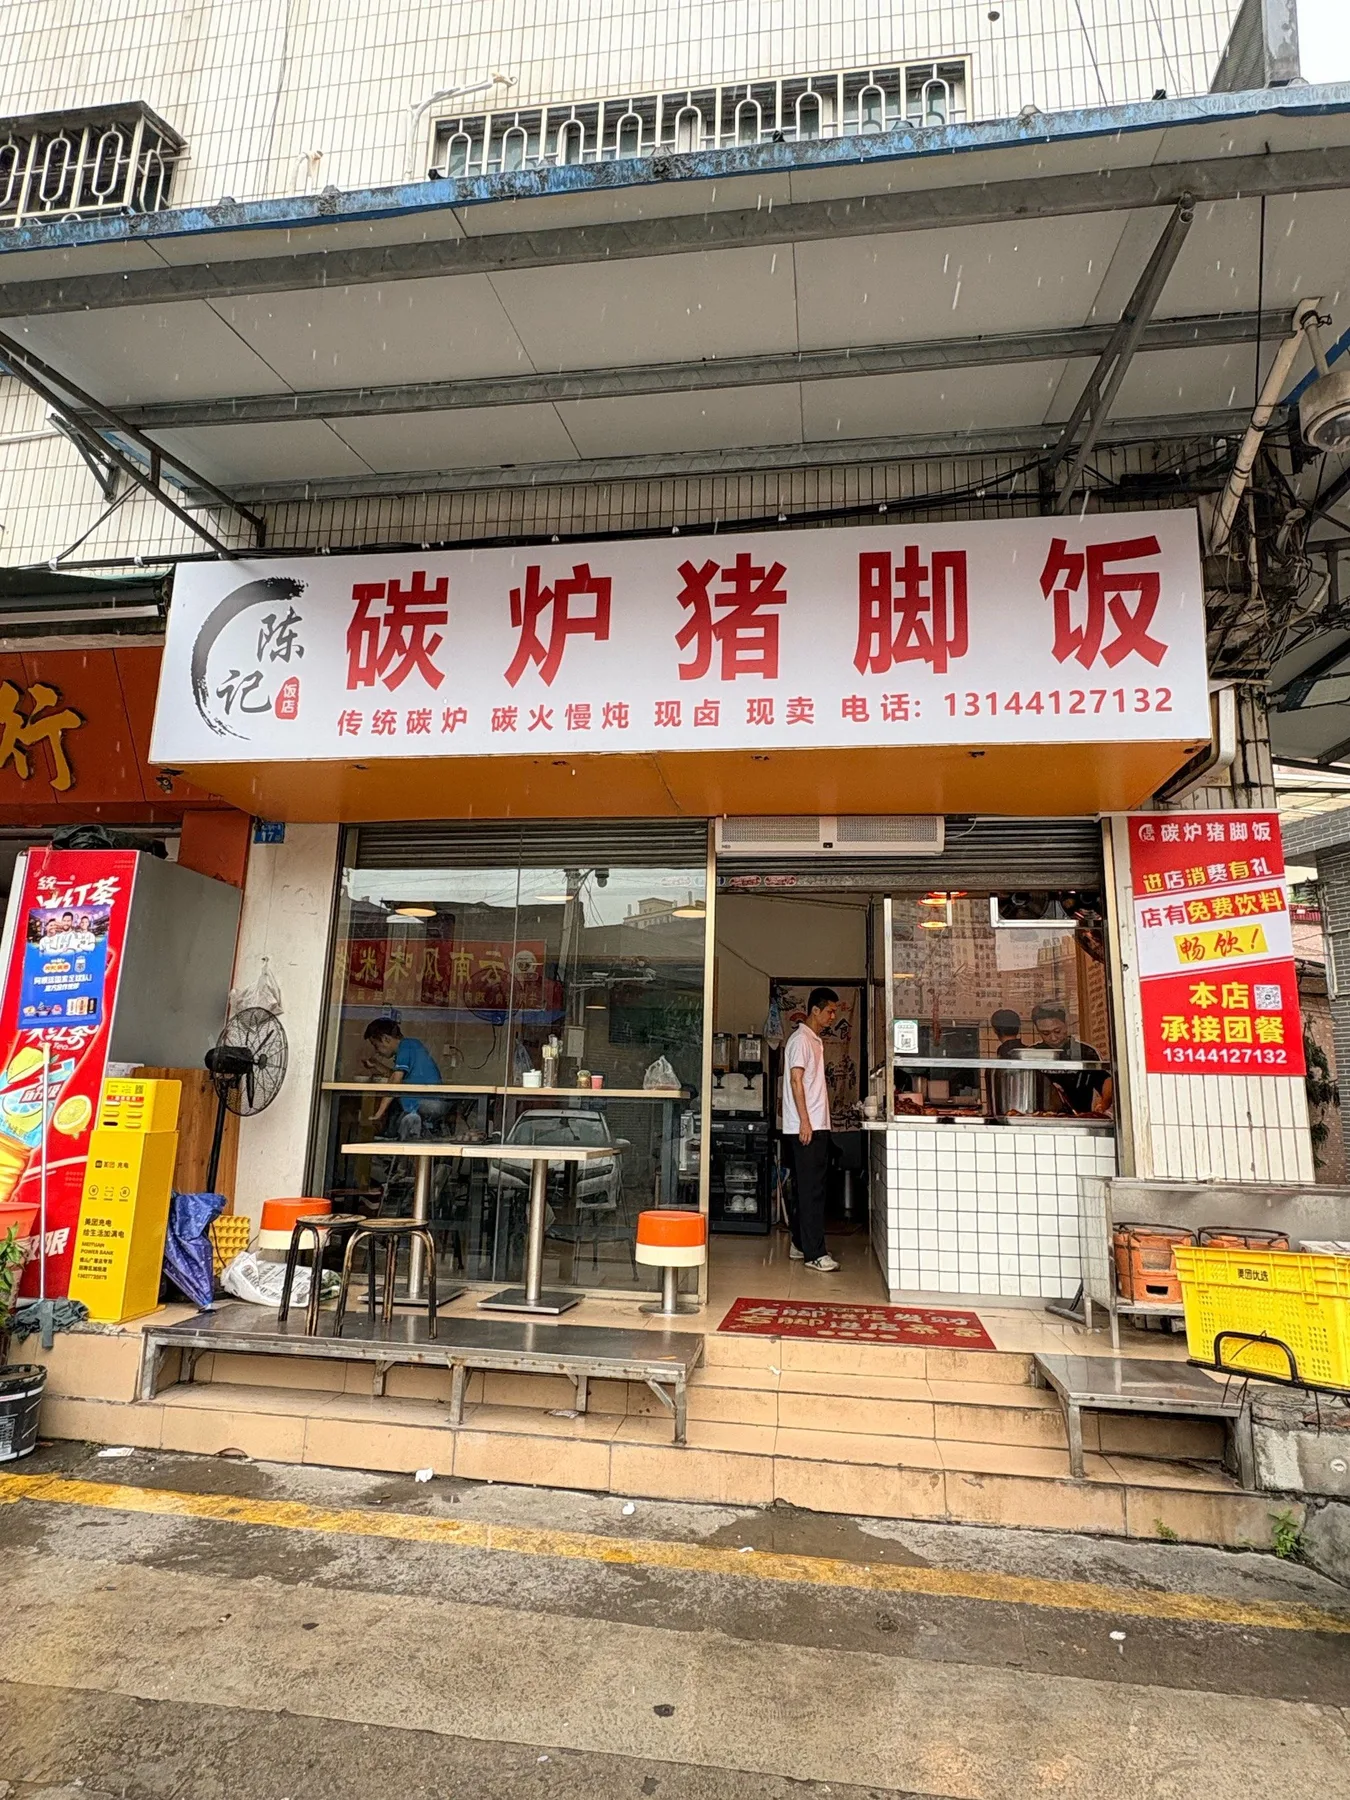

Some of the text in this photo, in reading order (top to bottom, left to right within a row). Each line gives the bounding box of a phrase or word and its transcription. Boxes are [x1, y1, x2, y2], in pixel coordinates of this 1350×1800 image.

[345, 535, 1169, 692] 碳炉猪脚饭
[279, 683, 298, 715] 饭店
[337, 706, 468, 736] 传统碳炉
[491, 701, 630, 732] 碳火慢炖
[654, 699, 720, 728] 现卤
[746, 696, 814, 726] 现卖
[944, 687, 1173, 716] 13144127132
[1161, 821, 1271, 843] 碳炉猪脚饭
[1142, 856, 1273, 893] 进店消费有礼
[1140, 889, 1283, 929] 店有免费饮料
[1188, 981, 1249, 1010] 本店
[1160, 1014, 1285, 1044] 承接团餐
[1162, 1047, 1287, 1064] 13144127132
[1237, 1269, 1269, 1282] 美团优选
